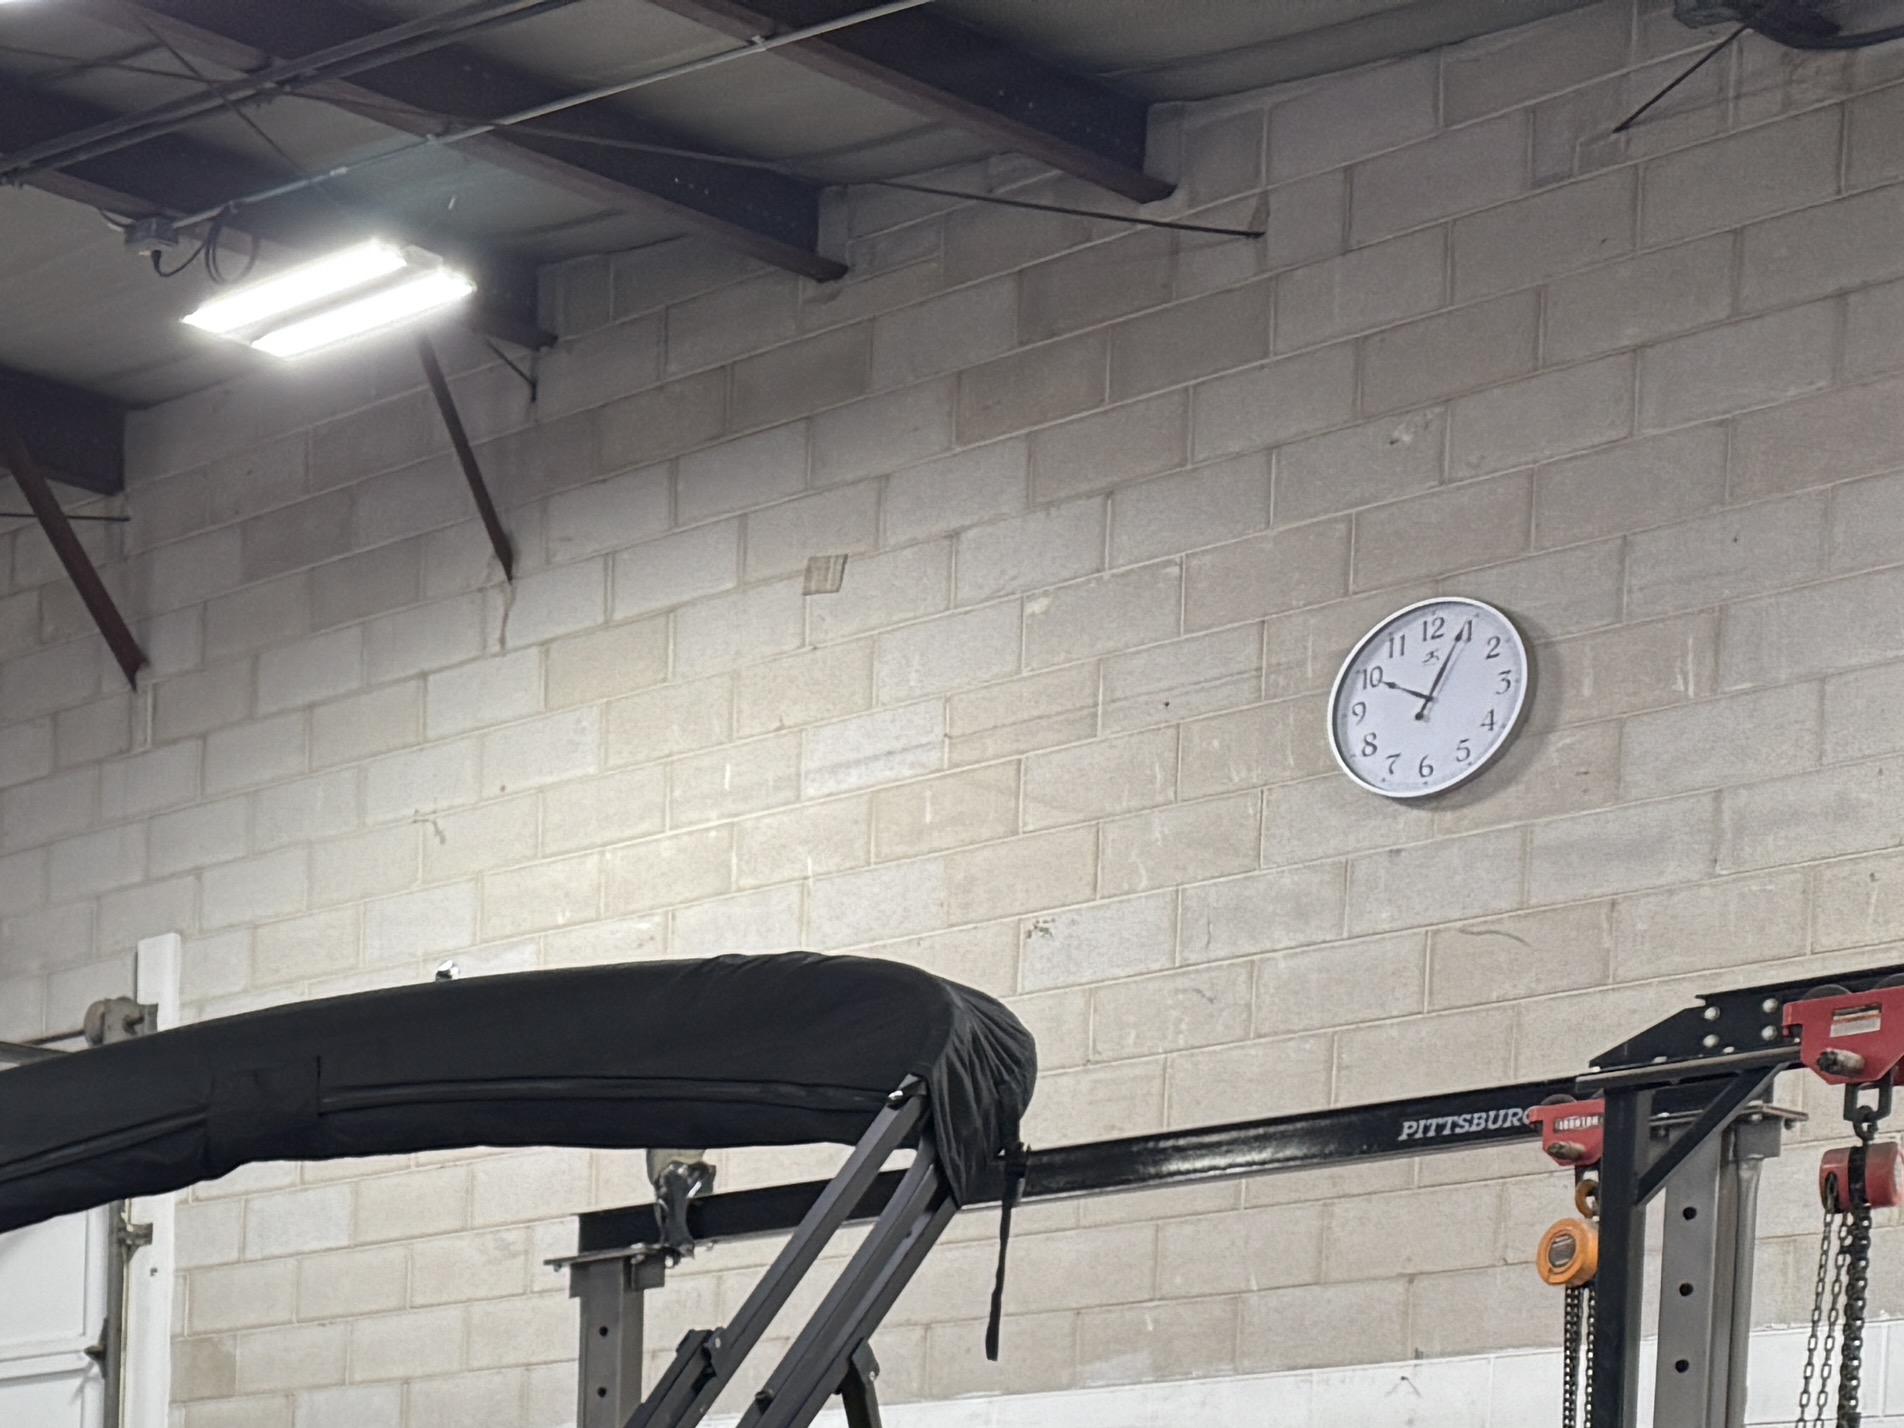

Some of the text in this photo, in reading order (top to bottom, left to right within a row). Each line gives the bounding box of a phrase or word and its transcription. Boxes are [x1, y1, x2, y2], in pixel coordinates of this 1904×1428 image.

[1422, 617, 1445, 642] 12
[1388, 634, 1406, 659] 11
[1485, 636, 1501, 660] 2
[1362, 665, 1383, 690] 10
[1495, 670, 1511, 695] 3
[1352, 701, 1367, 726] 9
[1480, 709, 1496, 731] 4
[1361, 732, 1378, 757] 8
[1456, 738, 1471, 762] 5
[1385, 753, 1401, 775] 7
[1419, 755, 1434, 778] 6
